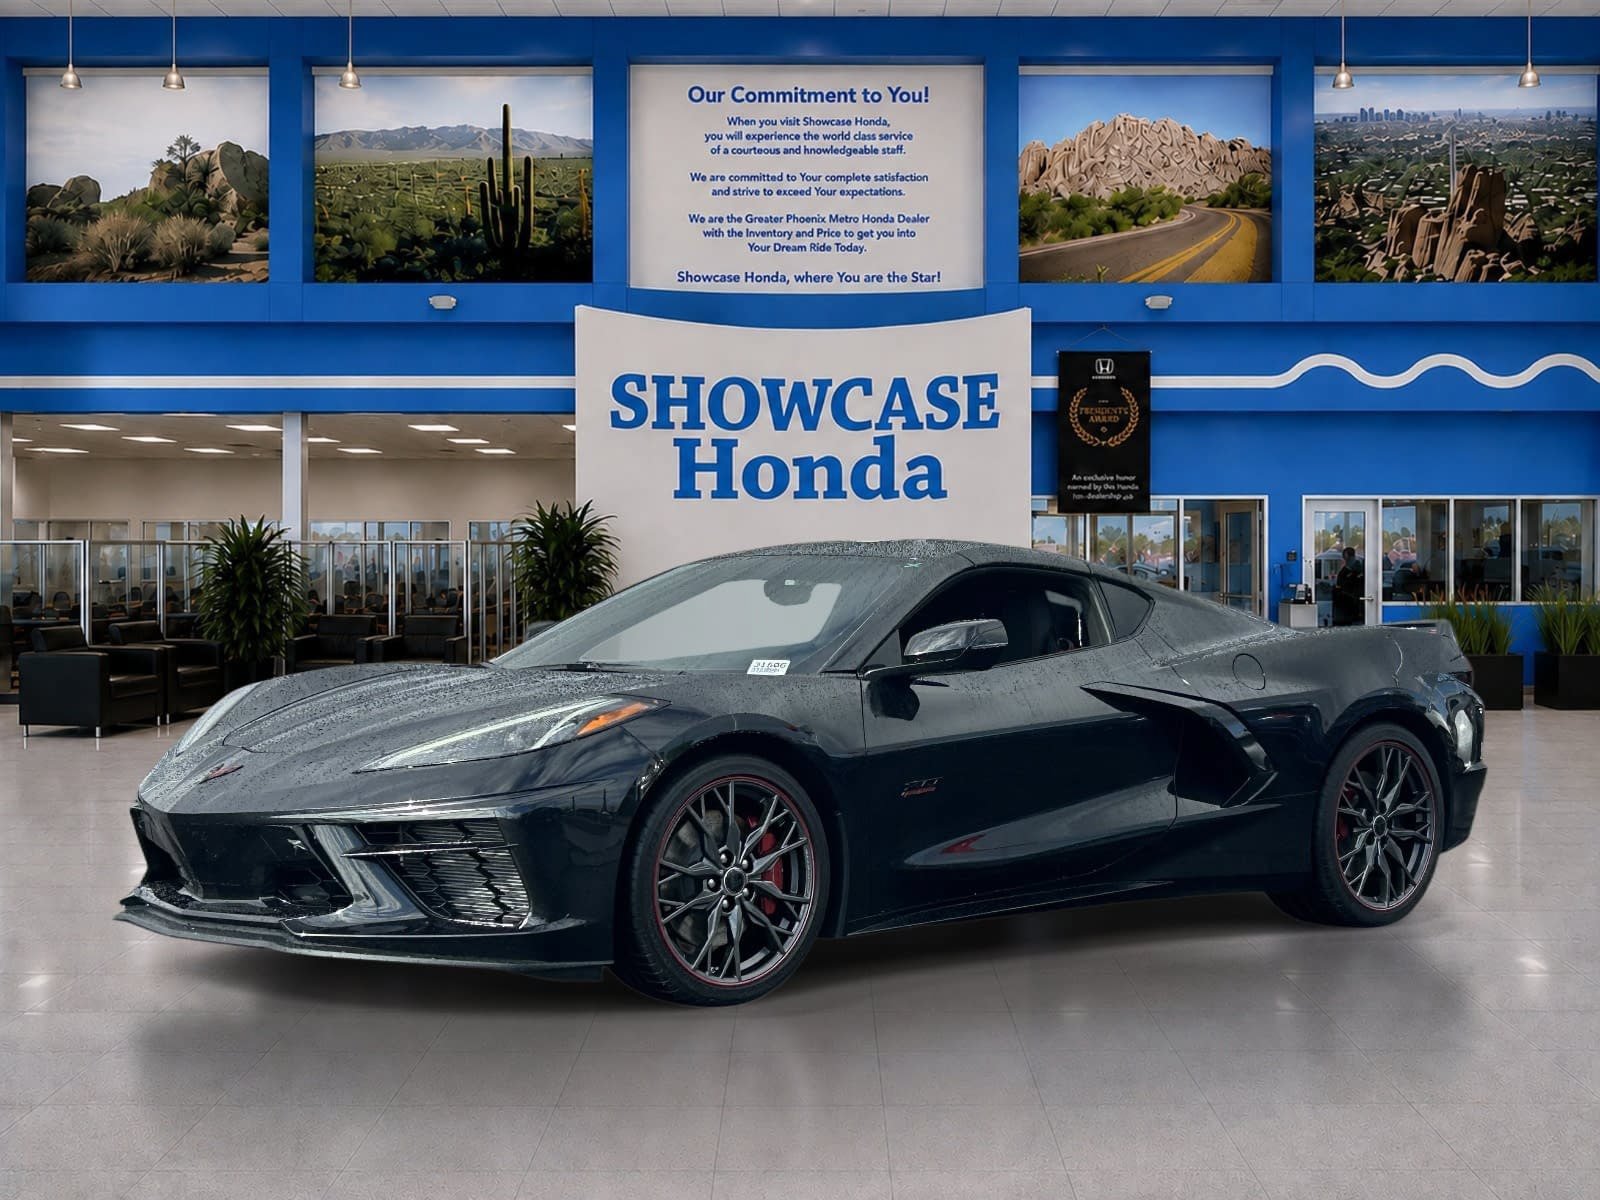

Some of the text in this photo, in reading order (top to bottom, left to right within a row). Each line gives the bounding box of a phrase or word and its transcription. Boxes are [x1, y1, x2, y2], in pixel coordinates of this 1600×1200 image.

[688, 86, 929, 103] Our Commitment to You!
[727, 116, 890, 129] When you visit Showcase Honda,
[705, 131, 913, 143] you will experience the world class service
[710, 145, 721, 155] of
[731, 147, 781, 155] courteous
[783, 145, 801, 155] and
[882, 144, 906, 155] staff.
[690, 172, 707, 182] We
[728, 172, 784, 182] committed
[786, 174, 797, 182] to
[800, 172, 822, 182] Your
[825, 172, 871, 184] complete
[874, 172, 929, 182] satisfaction
[712, 186, 905, 199] and strive to exceed Your expectations.
[688, 214, 930, 224] We are the Greater Phoenix Metro Honda Dealer
[703, 228, 916, 241] with the Inventory and Price to get you into
[748, 242, 867, 255] Your Dream Ride Today.
[678, 271, 941, 285] Showcase Honda, where You are the Star!
[610, 372, 1000, 432] SHOWCASE
[672, 434, 948, 501] Honda
